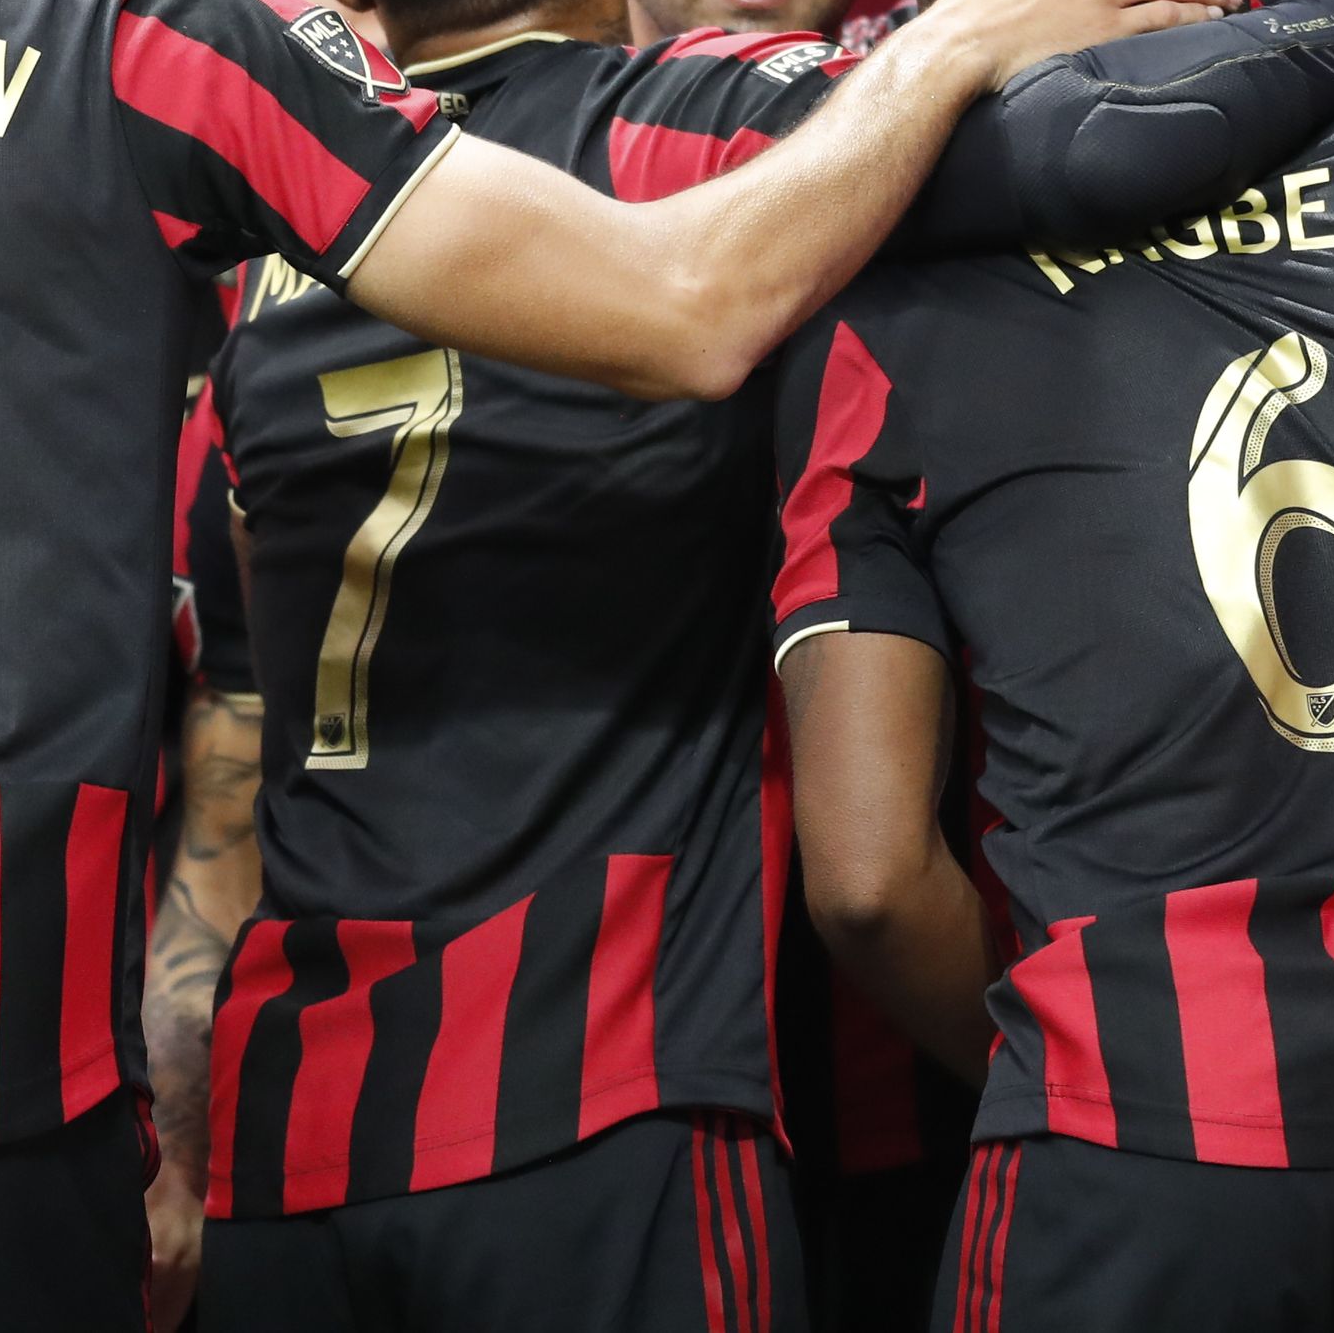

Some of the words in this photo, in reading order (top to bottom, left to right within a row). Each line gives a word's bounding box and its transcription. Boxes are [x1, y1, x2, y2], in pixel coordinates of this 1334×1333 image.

[303, 14, 345, 47] MLS
[769, 46, 827, 73] MLS
[304, 347, 464, 771] 7
